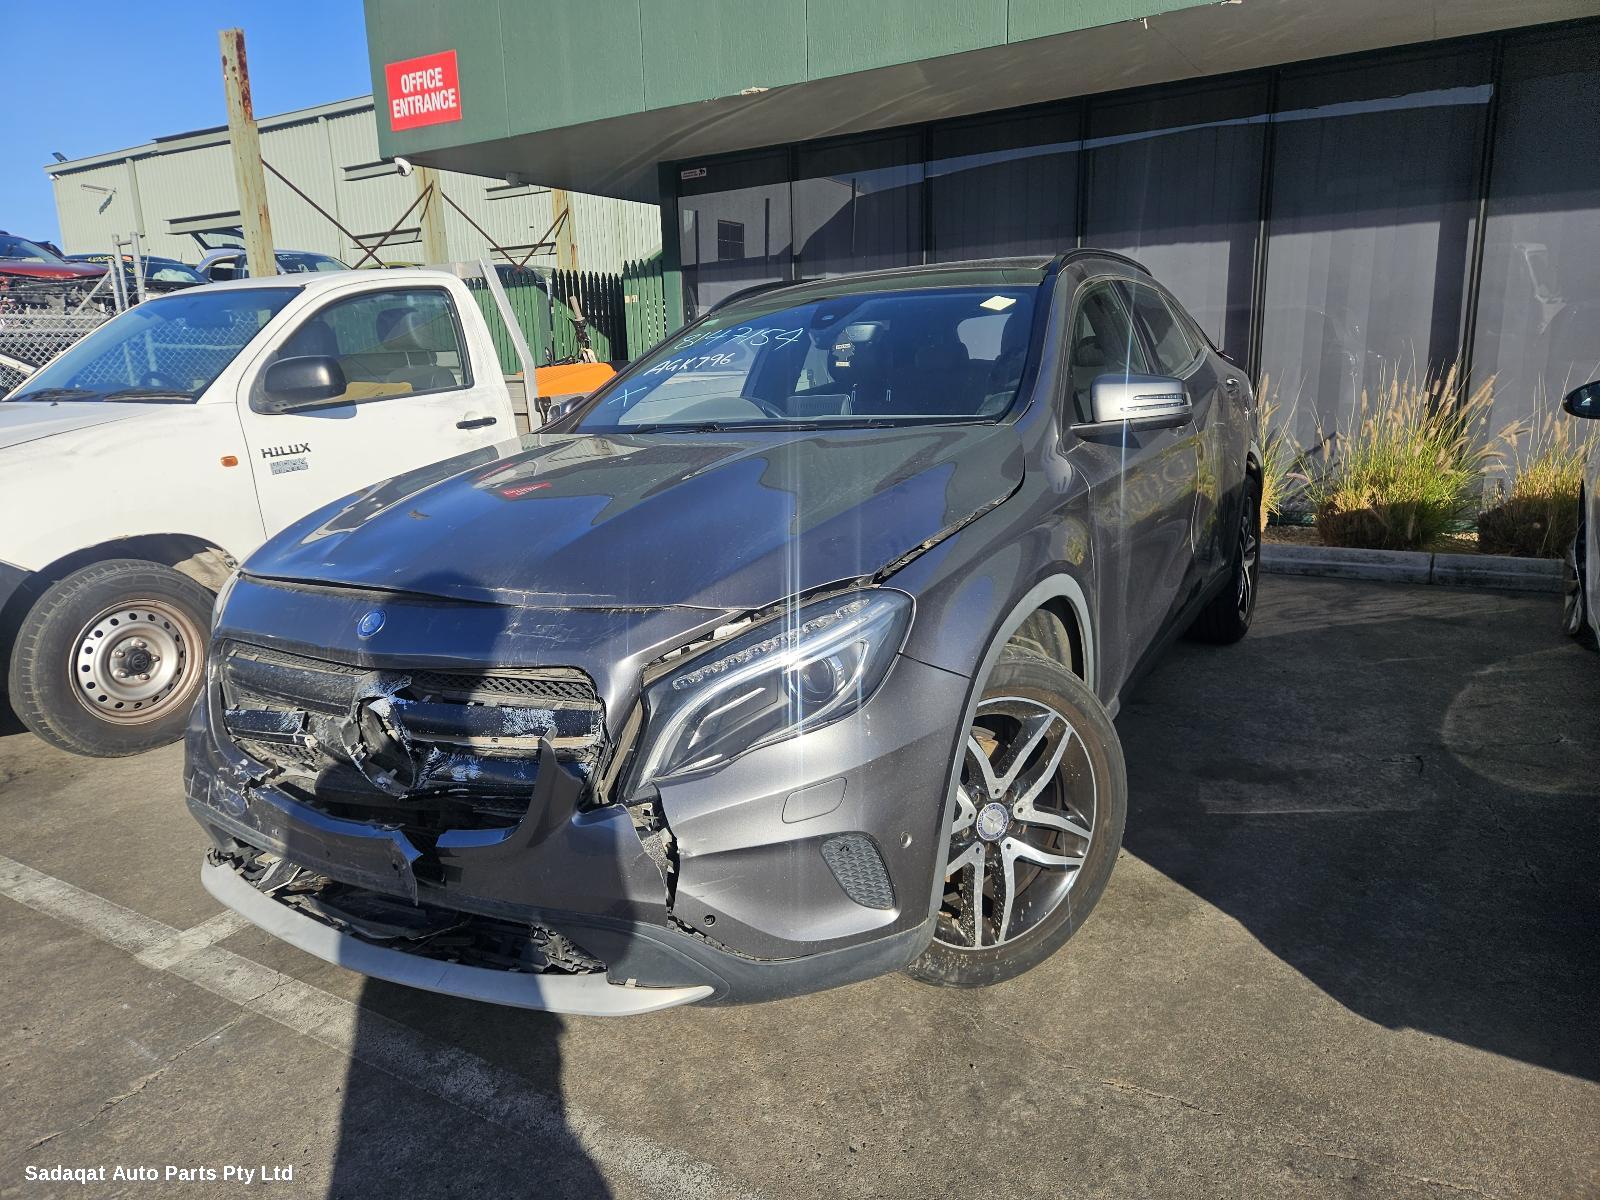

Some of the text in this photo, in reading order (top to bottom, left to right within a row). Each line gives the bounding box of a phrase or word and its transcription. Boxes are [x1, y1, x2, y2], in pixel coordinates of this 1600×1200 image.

[401, 67, 443, 94] OFFICE
[392, 88, 457, 118] ENTRANCE
[260, 442, 311, 459] HILUX
